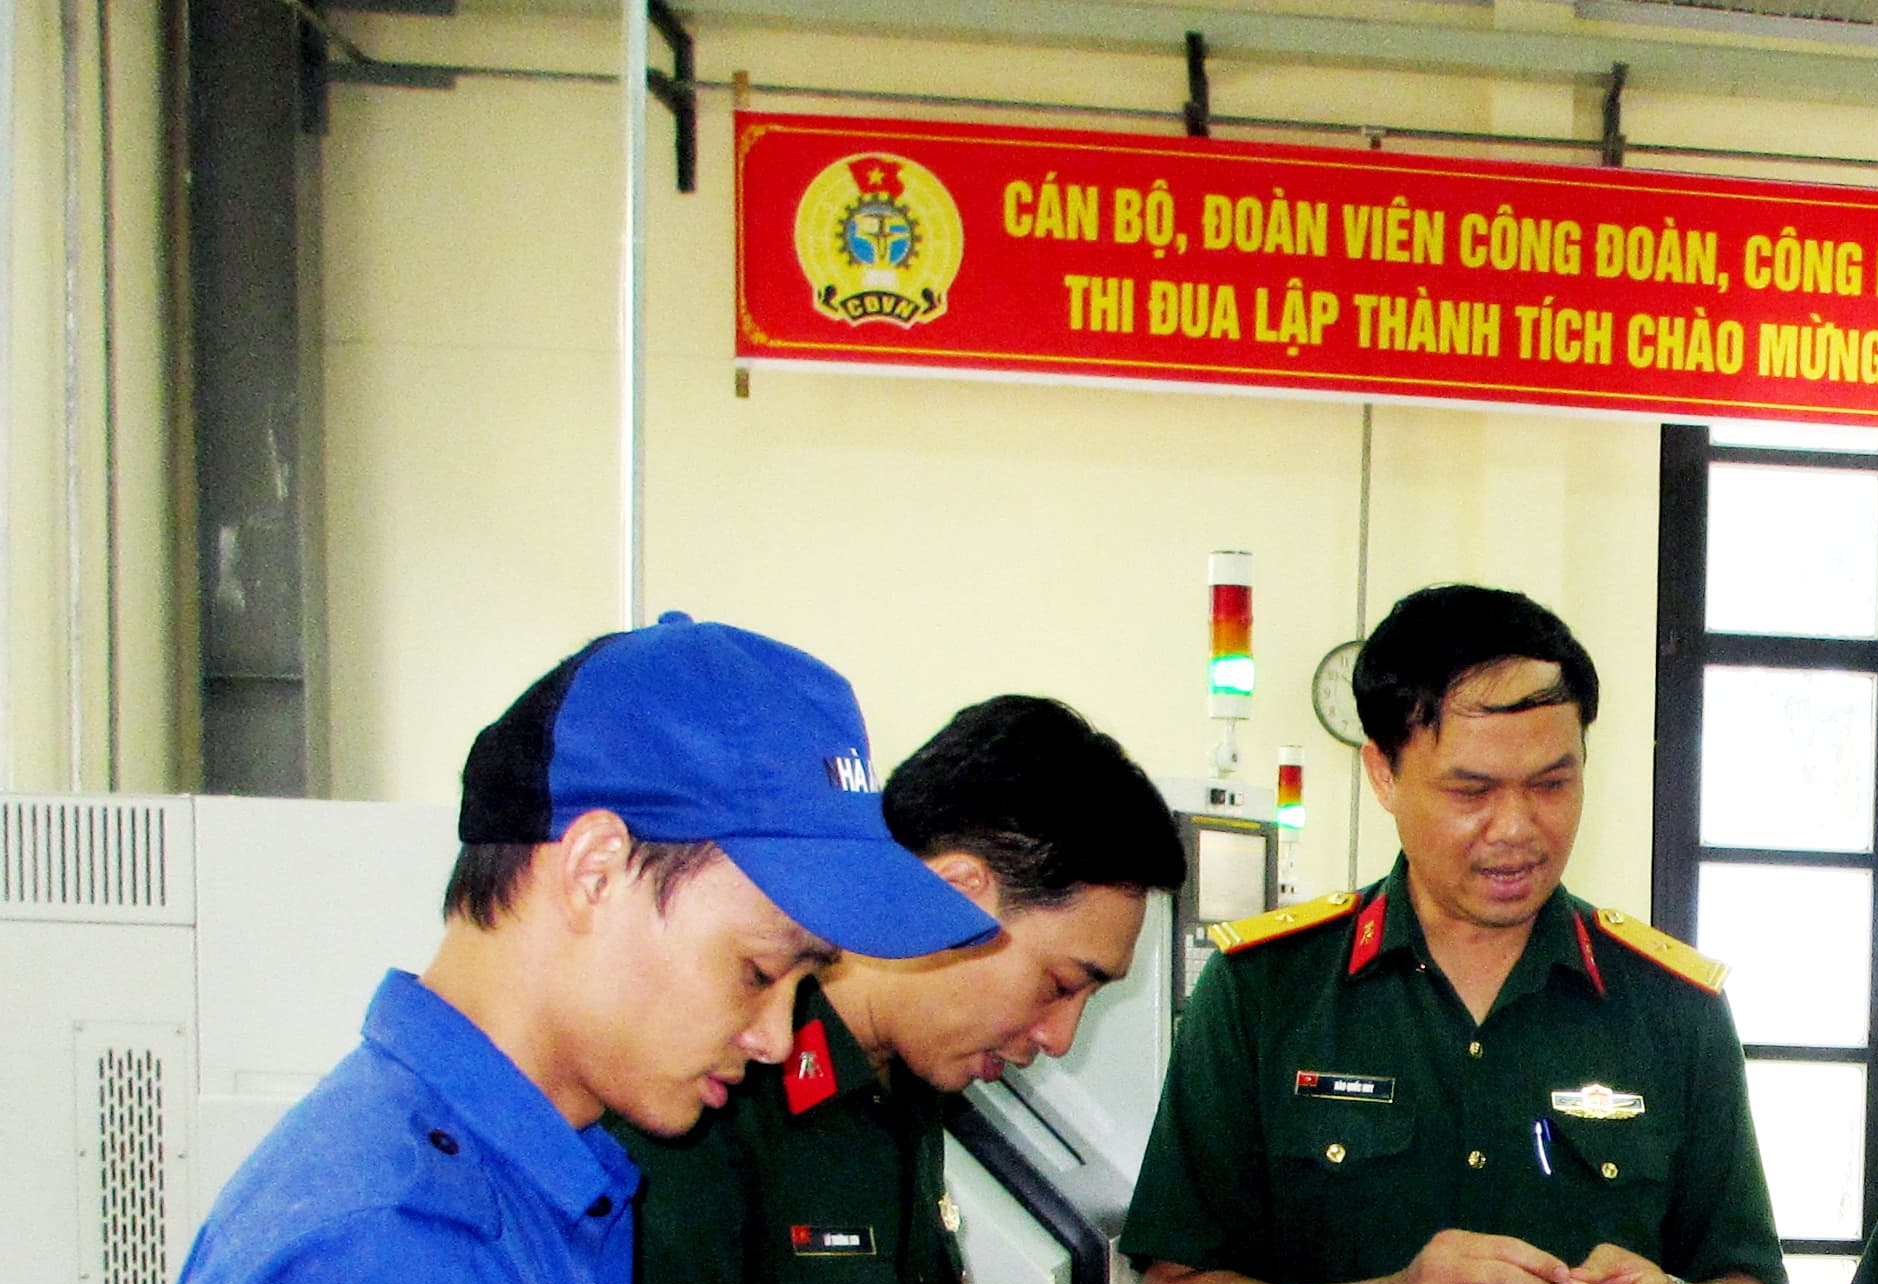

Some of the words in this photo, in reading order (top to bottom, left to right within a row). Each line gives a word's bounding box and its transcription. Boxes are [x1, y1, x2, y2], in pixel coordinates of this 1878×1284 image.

[1003, 171, 1099, 242] CÁN
[1113, 178, 1188, 259] BỘ,
[1201, 187, 1328, 257] ĐOÀN
[1342, 195, 1445, 265] VIÊN
[1459, 203, 1582, 276] CÔNG
[1594, 216, 1730, 294] ĐOÀN,
[1743, 225, 1864, 297] CÔNG
[1063, 274, 1135, 334] THI
[1147, 279, 1241, 341] ĐUA
[1254, 277, 1340, 357] LẬP
[1353, 286, 1501, 358] THÀNH
[1514, 295, 1614, 366] TÍCH
[1626, 306, 1746, 376] CHÀO
